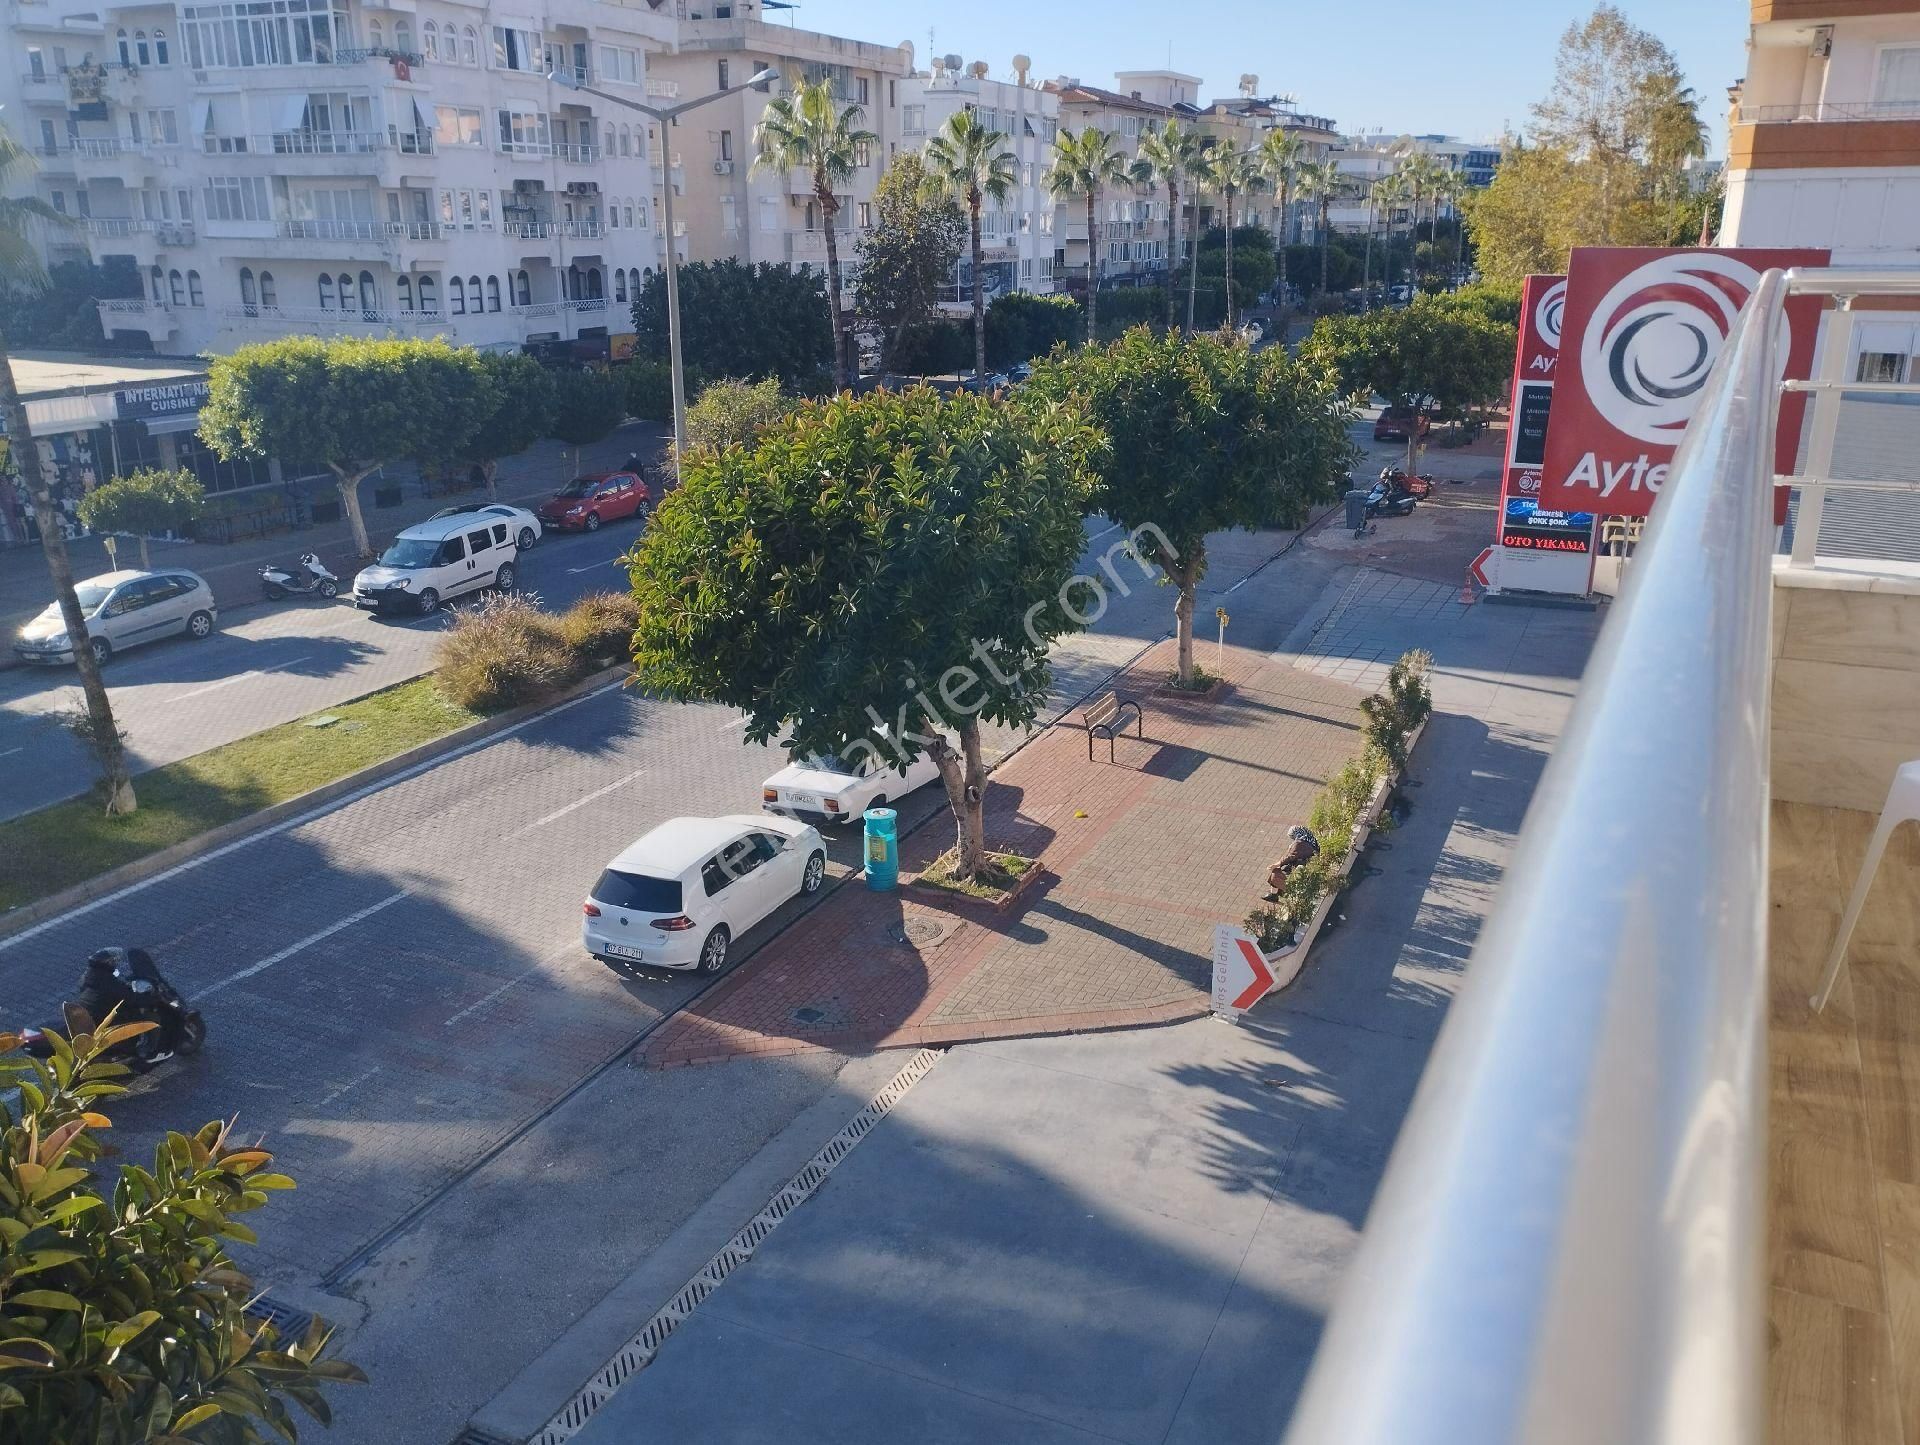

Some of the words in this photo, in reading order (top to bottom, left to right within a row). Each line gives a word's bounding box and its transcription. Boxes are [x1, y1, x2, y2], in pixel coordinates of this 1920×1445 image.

[125, 383, 210, 403] INTERNATINA
[151, 397, 196, 411] CUISINE
[1563, 452, 1670, 497] Ayte
[1503, 536, 1532, 547] OTO
[1535, 538, 1587, 551] YIKAMA
